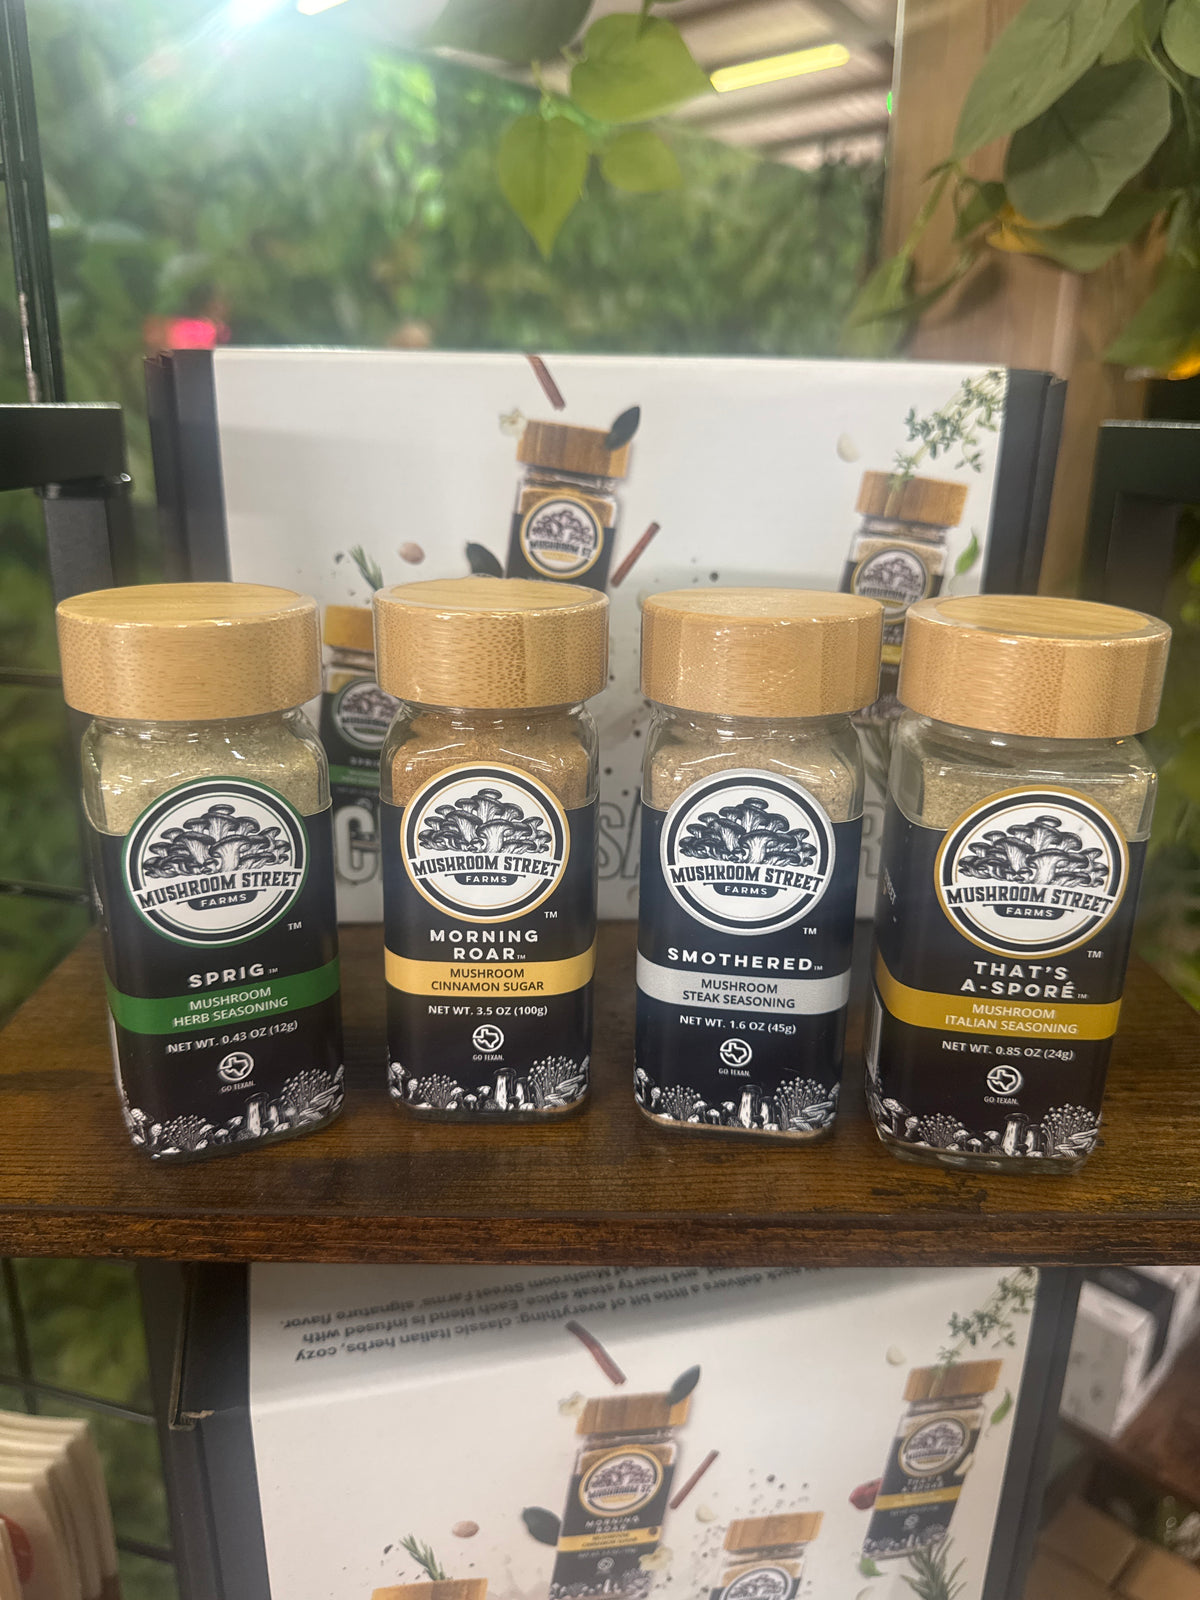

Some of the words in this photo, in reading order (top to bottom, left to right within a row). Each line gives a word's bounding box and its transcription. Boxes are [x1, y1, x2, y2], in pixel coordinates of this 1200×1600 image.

[411, 855, 499, 877] MUSHROOM
[503, 855, 561, 878] STREET
[465, 875, 508, 883] FARMS
[669, 865, 760, 884] MUSHROOM
[765, 868, 825, 893] STREET
[136, 873, 237, 909] MUSHROOM
[241, 871, 302, 888] STREET
[724, 885, 768, 895] FARMS
[200, 893, 248, 908] FARMS
[945, 886, 1048, 905] MUSHROOM
[1051, 888, 1114, 915] STREET
[544, 911, 558, 919] TM
[1005, 907, 1054, 918] FARMS
[287, 921, 302, 931] TM
[802, 927, 817, 935] TM
[429, 929, 539, 943] MORNING
[453, 947, 515, 960] ROAR
[667, 947, 813, 971] SMOTHERED
[1086, 950, 1103, 959] TM
[188, 963, 265, 988] SPRIG
[449, 968, 525, 979] MUSHROOM
[973, 960, 1070, 981] THAT'S
[431, 980, 500, 992] CINNAMON
[503, 981, 544, 992] SUGAR
[701, 978, 778, 994] MUSHROOM
[960, 978, 1077, 999] A-SPORÉ
[189, 986, 272, 1011] MUSHROOM
[682, 990, 720, 1004] STEAK
[723, 994, 796, 1009] SEASONING
[172, 1013, 210, 1027] HERB
[213, 996, 289, 1022] SEASONING
[428, 1005, 450, 1015] NET
[452, 1006, 474, 1016] WT.
[476, 1006, 493, 1016] 3.5
[495, 1006, 512, 1016] OZ
[514, 1005, 548, 1017] (100g)
[971, 1003, 1056, 1019] MUSHROOM
[679, 1014, 703, 1026] NET
[704, 1018, 726, 1028] WT.
[729, 1020, 746, 1030] 1.6
[748, 1021, 765, 1031] OZ
[767, 1022, 797, 1035] (45g)
[945, 1014, 997, 1030] ITALIAN
[1000, 1020, 1078, 1034] SEASONING
[166, 1041, 193, 1054] NET
[195, 1037, 219, 1049] WT.
[222, 1031, 247, 1045] 0.43
[250, 1027, 268, 1038] OZ
[269, 1019, 298, 1036] (12g)
[941, 1040, 967, 1051] NET
[969, 1043, 992, 1054] WT.
[995, 1045, 1021, 1057] 0.85
[1023, 1047, 1042, 1058] OZ
[1043, 1048, 1074, 1061] (24g)
[220, 1085, 232, 1093] GO
[475, 1282, 525, 1299] Street
[618, 1275, 669, 1290] hearty
[572, 1283, 616, 1299] steak
[630, 1291, 652, 1306] bit
[653, 1286, 689, 1302] little
[336, 1299, 415, 1320] signature
[478, 1299, 519, 1315] Each
[611, 1298, 626, 1310] of
[280, 1312, 332, 1329] flavor.
[411, 1314, 426, 1325] is
[429, 1306, 476, 1323] blend
[345, 1317, 408, 1337] infused
[454, 1317, 512, 1336] classic
[302, 1328, 341, 1344] with
[399, 1327, 452, 1344] Italian
[341, 1336, 396, 1352] herbs,
[295, 1346, 338, 1361] cozy
